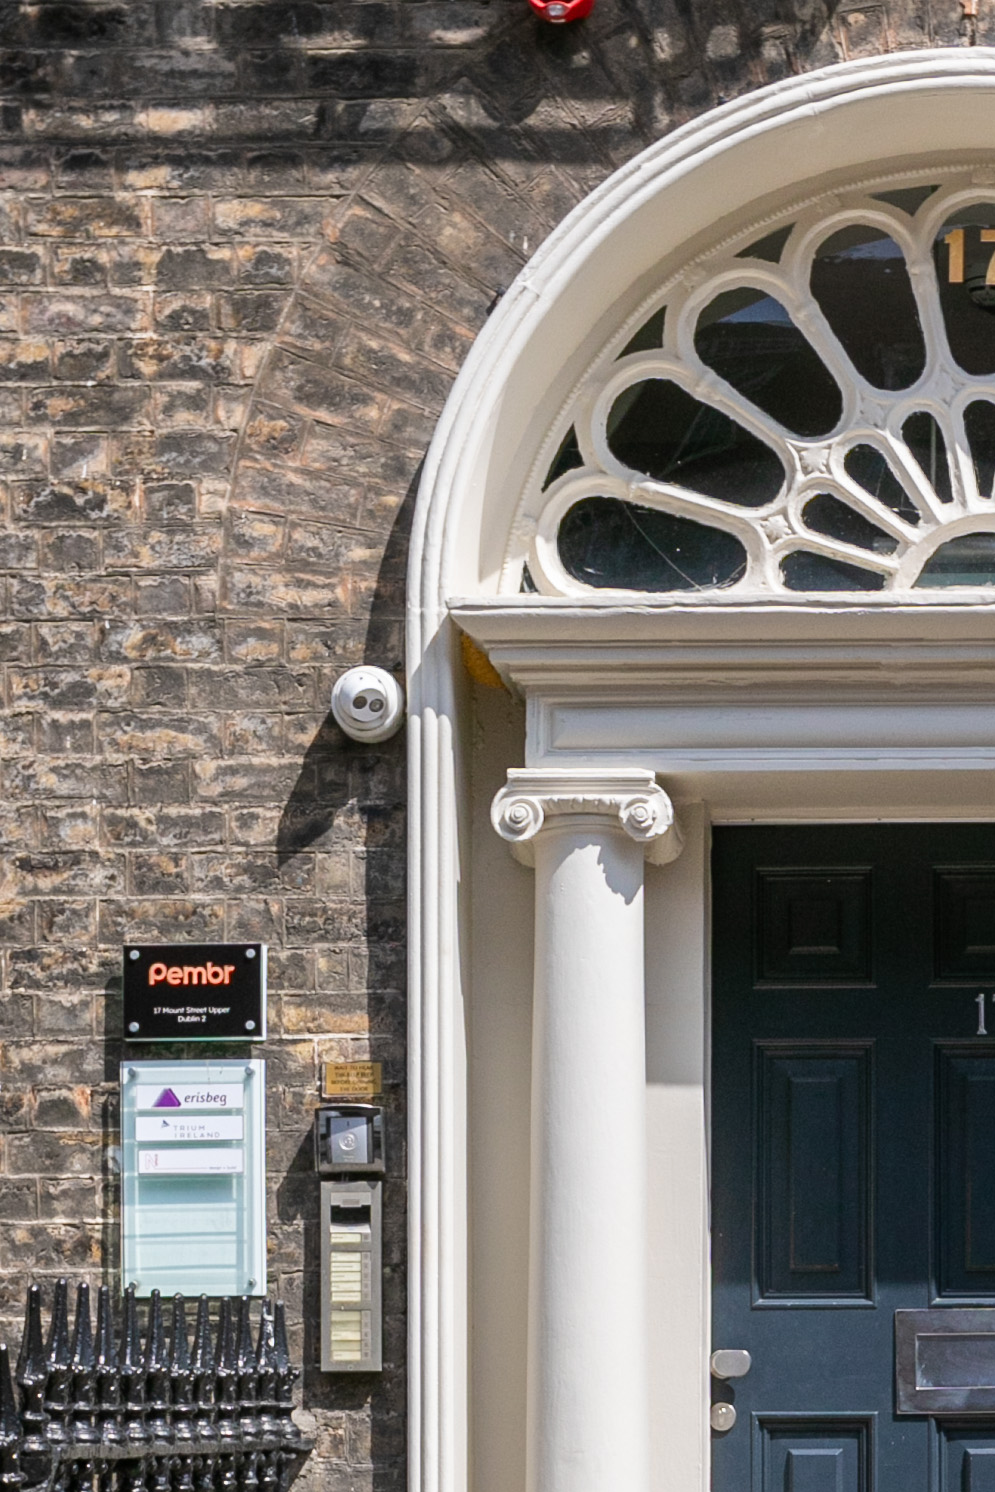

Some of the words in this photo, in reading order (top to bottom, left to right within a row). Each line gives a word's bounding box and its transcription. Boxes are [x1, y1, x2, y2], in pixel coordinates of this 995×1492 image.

[148, 961, 235, 986] Pembr
[153, 1006, 161, 1014] 17
[162, 1006, 185, 1014] Mount
[186, 1006, 207, 1014] Street
[208, 1006, 231, 1015] Upper
[177, 1015, 201, 1023] Dublin
[184, 1092, 227, 1106] erisbeg
[174, 1131, 221, 1139] IRELAND
